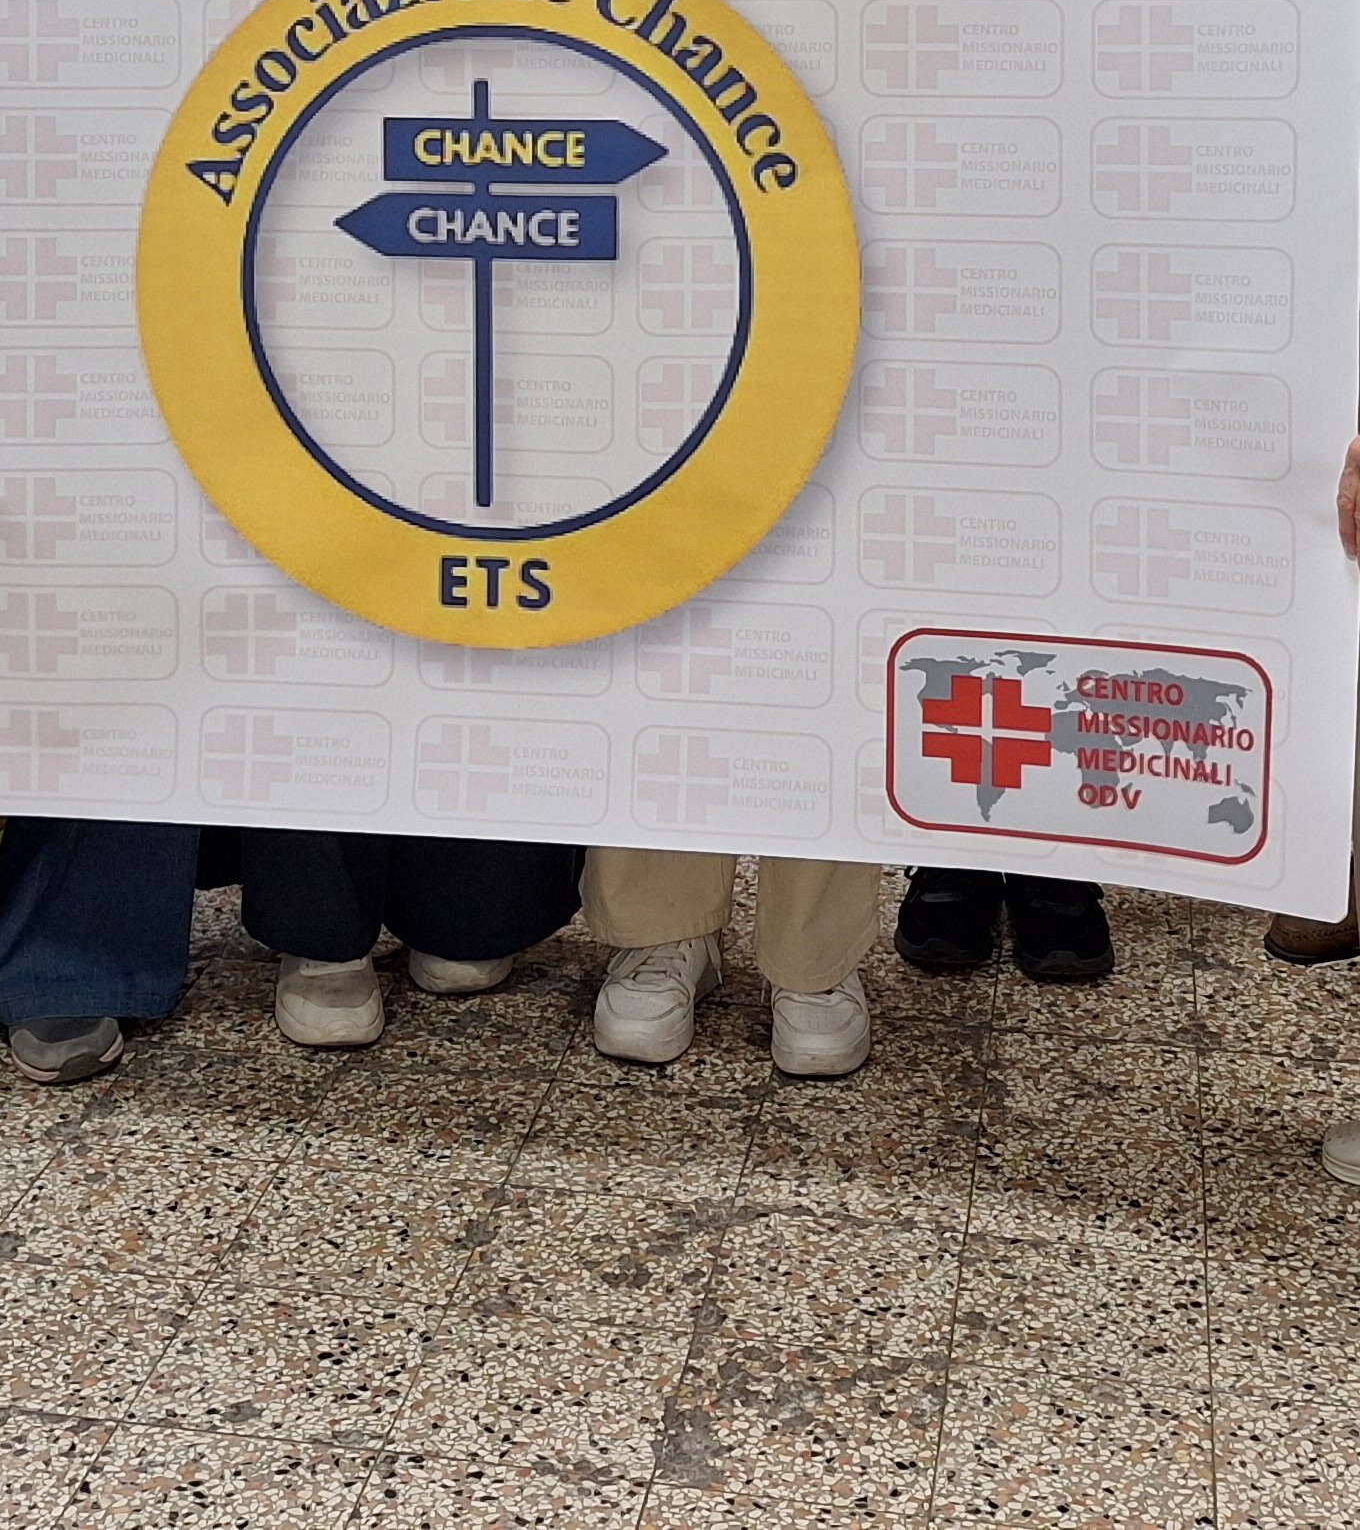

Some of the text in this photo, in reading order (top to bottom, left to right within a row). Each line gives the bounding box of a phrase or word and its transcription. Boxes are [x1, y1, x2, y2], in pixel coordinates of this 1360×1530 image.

[962, 23, 1020, 37] CENTRO
[1197, 23, 1256, 37] CENTRO
[962, 41, 1059, 55] MISSIONARIO
[1197, 41, 1295, 55] MISSIONARIO
[962, 59, 1047, 72] MEDICINALI
[1197, 59, 1283, 73] MEDICINALI
[413, 130, 587, 167] CHANCE
[960, 142, 1018, 155] CENTRO
[1196, 144, 1254, 158] CENTRO
[960, 159, 1057, 174] MISSIONARIO
[1196, 162, 1292, 177] MISSIONARIO
[960, 177, 1046, 192] MEDICINALI
[1196, 180, 1281, 195] MEDICINALI
[406, 208, 581, 246] CHANCE
[516, 379, 572, 393] CENTRO
[516, 396, 610, 411] MISSIONARIO
[960, 389, 1018, 404] CENTRO
[516, 413, 599, 428] MEDICINALI
[960, 407, 1057, 423] MISSIONARIO
[960, 424, 1044, 441] MEDICINALI
[439, 557, 552, 610] ETS
[1076, 675, 1185, 706] CENTRO
[1076, 710, 1255, 752] MISSIONARIO
[1076, 748, 1233, 787] MEDICINALI
[1077, 781, 1142, 811] ODV
